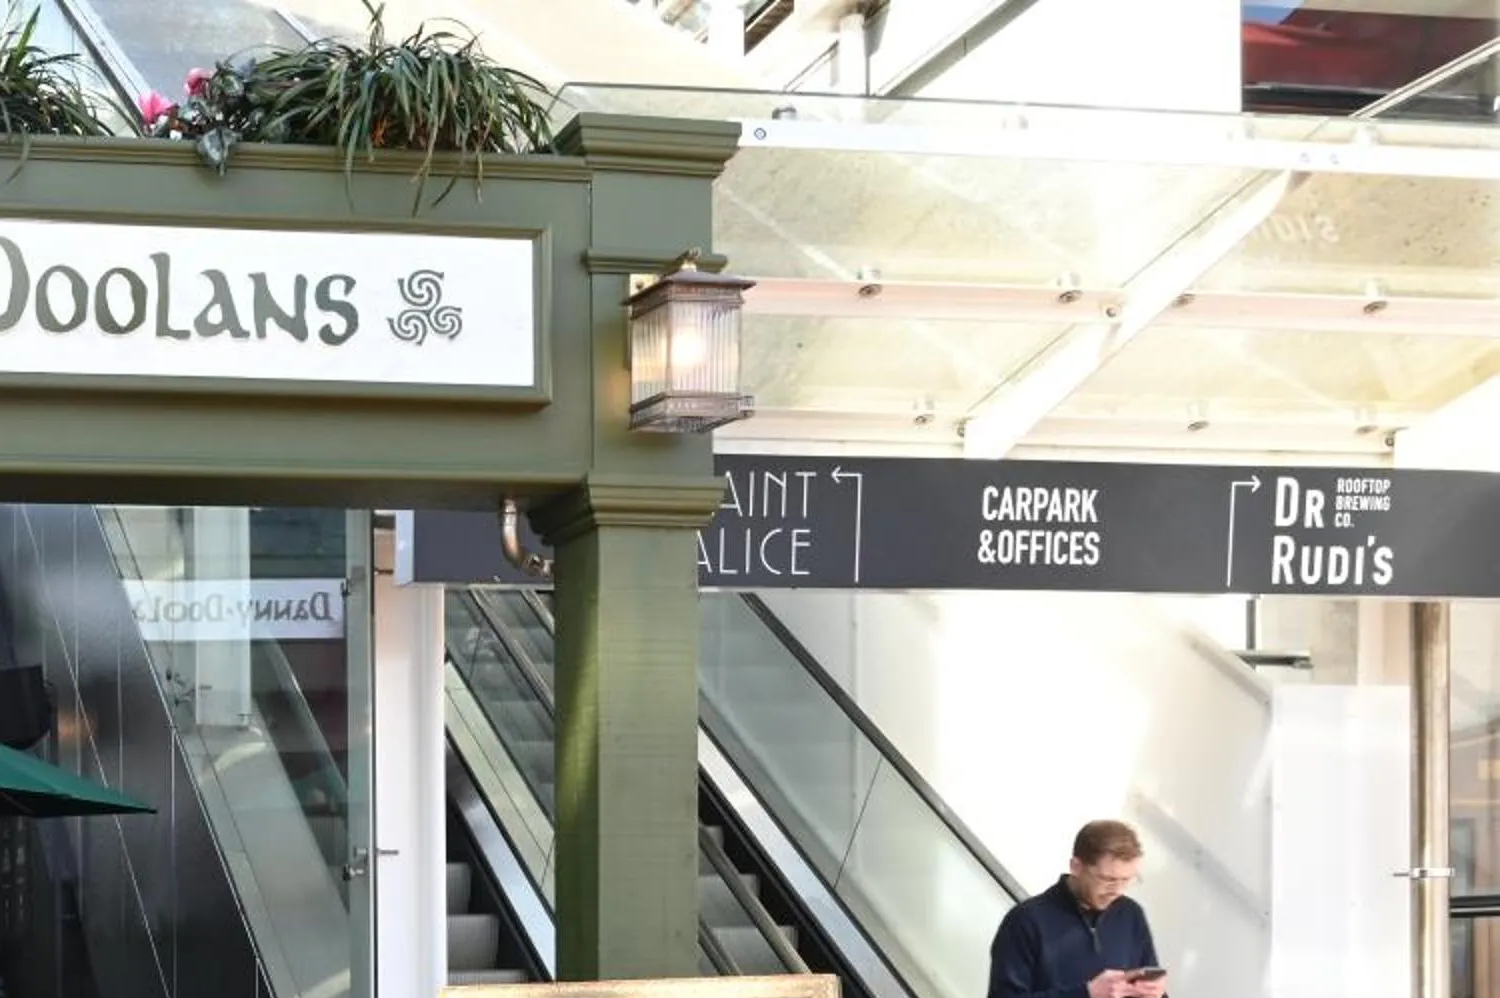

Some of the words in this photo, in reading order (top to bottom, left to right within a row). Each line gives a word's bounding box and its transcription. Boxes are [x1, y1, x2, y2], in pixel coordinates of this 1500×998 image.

[711, 470, 817, 518] AINT
[982, 485, 1100, 523] CARPARK
[1274, 476, 1325, 529] DR
[1335, 494, 1391, 511] BREWING
[1336, 476, 1391, 494] ROOFTOP
[1334, 511, 1355, 528] CO.
[696, 528, 811, 575] ALICE
[977, 529, 1100, 566] &OFFICES
[1271, 535, 1394, 586] RUDI'S
